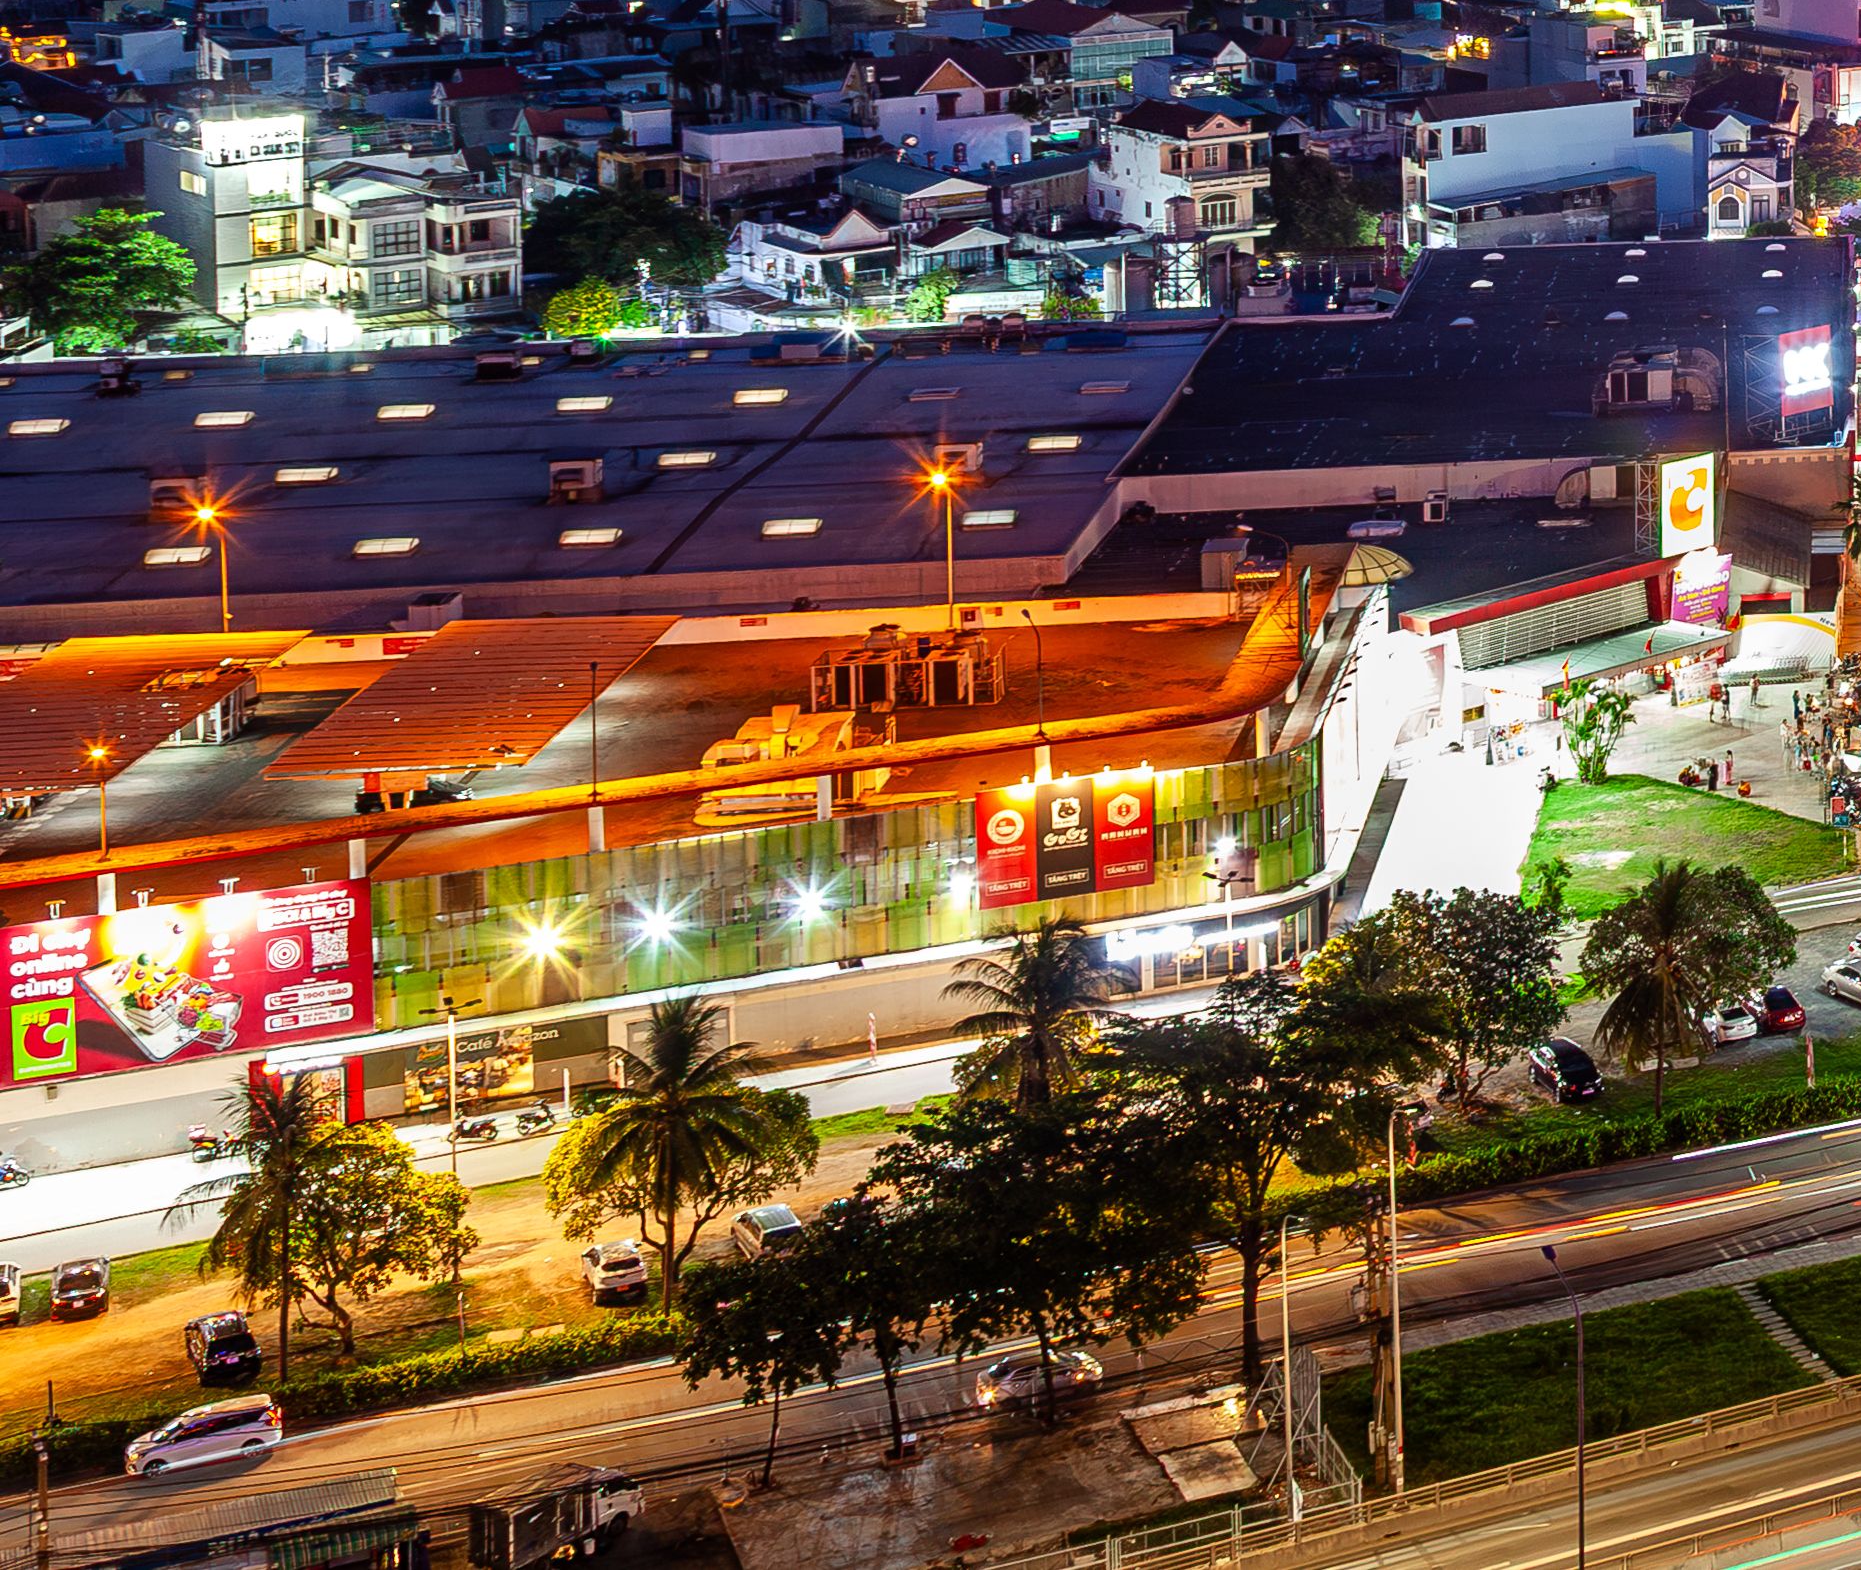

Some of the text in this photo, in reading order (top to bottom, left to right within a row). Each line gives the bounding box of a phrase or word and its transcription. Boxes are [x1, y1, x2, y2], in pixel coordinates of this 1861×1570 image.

[10, 952, 89, 977] online
[10, 976, 74, 999] cùng
[456, 1028, 560, 1054] Café Amazon
